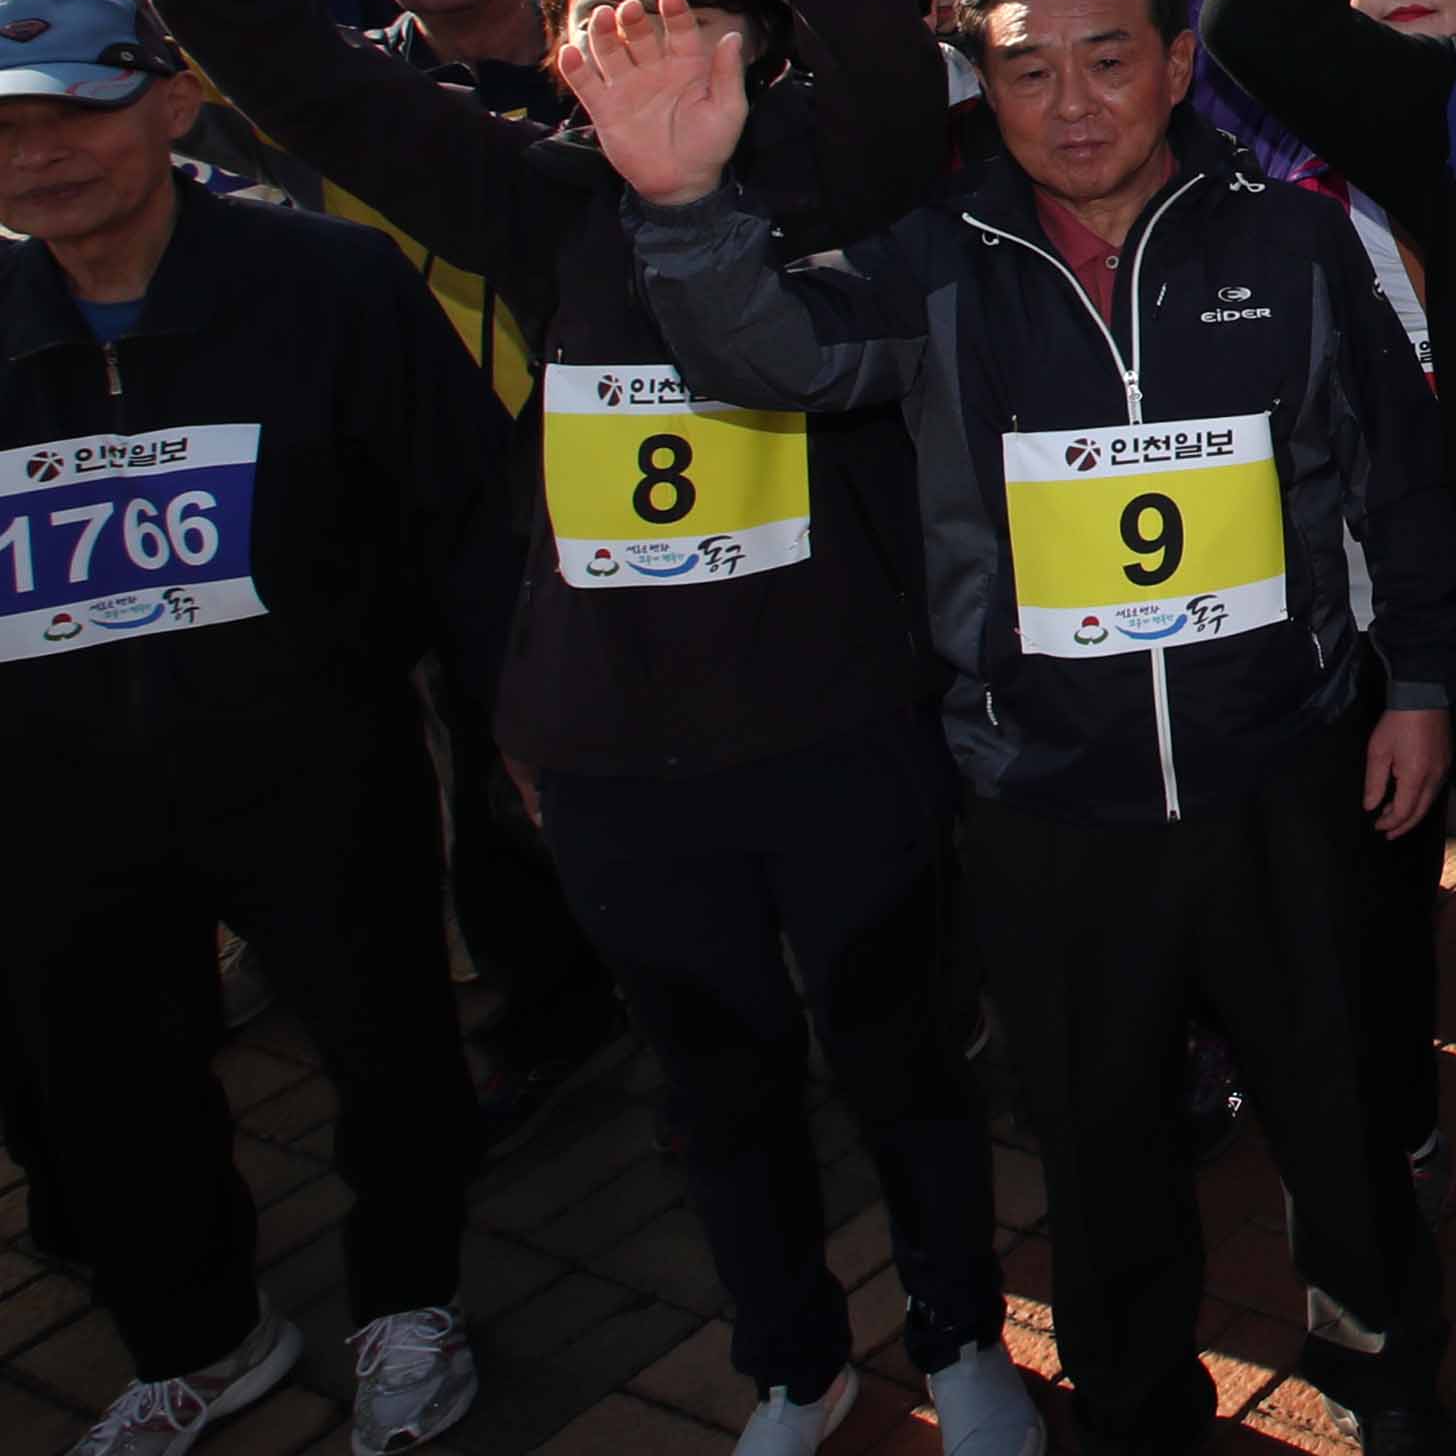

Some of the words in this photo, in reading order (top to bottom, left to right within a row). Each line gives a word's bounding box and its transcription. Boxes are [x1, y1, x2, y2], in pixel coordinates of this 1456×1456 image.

[75, 437, 190, 474] 인천일보
[1111, 429, 1235, 466] 인천일보
[632, 433, 697, 524] 8
[0, 490, 219, 594] 1766
[698, 535, 746, 575] 동구
[1120, 492, 1184, 587] 9
[163, 588, 201, 625] 동구
[1185, 594, 1230, 635] 동구
